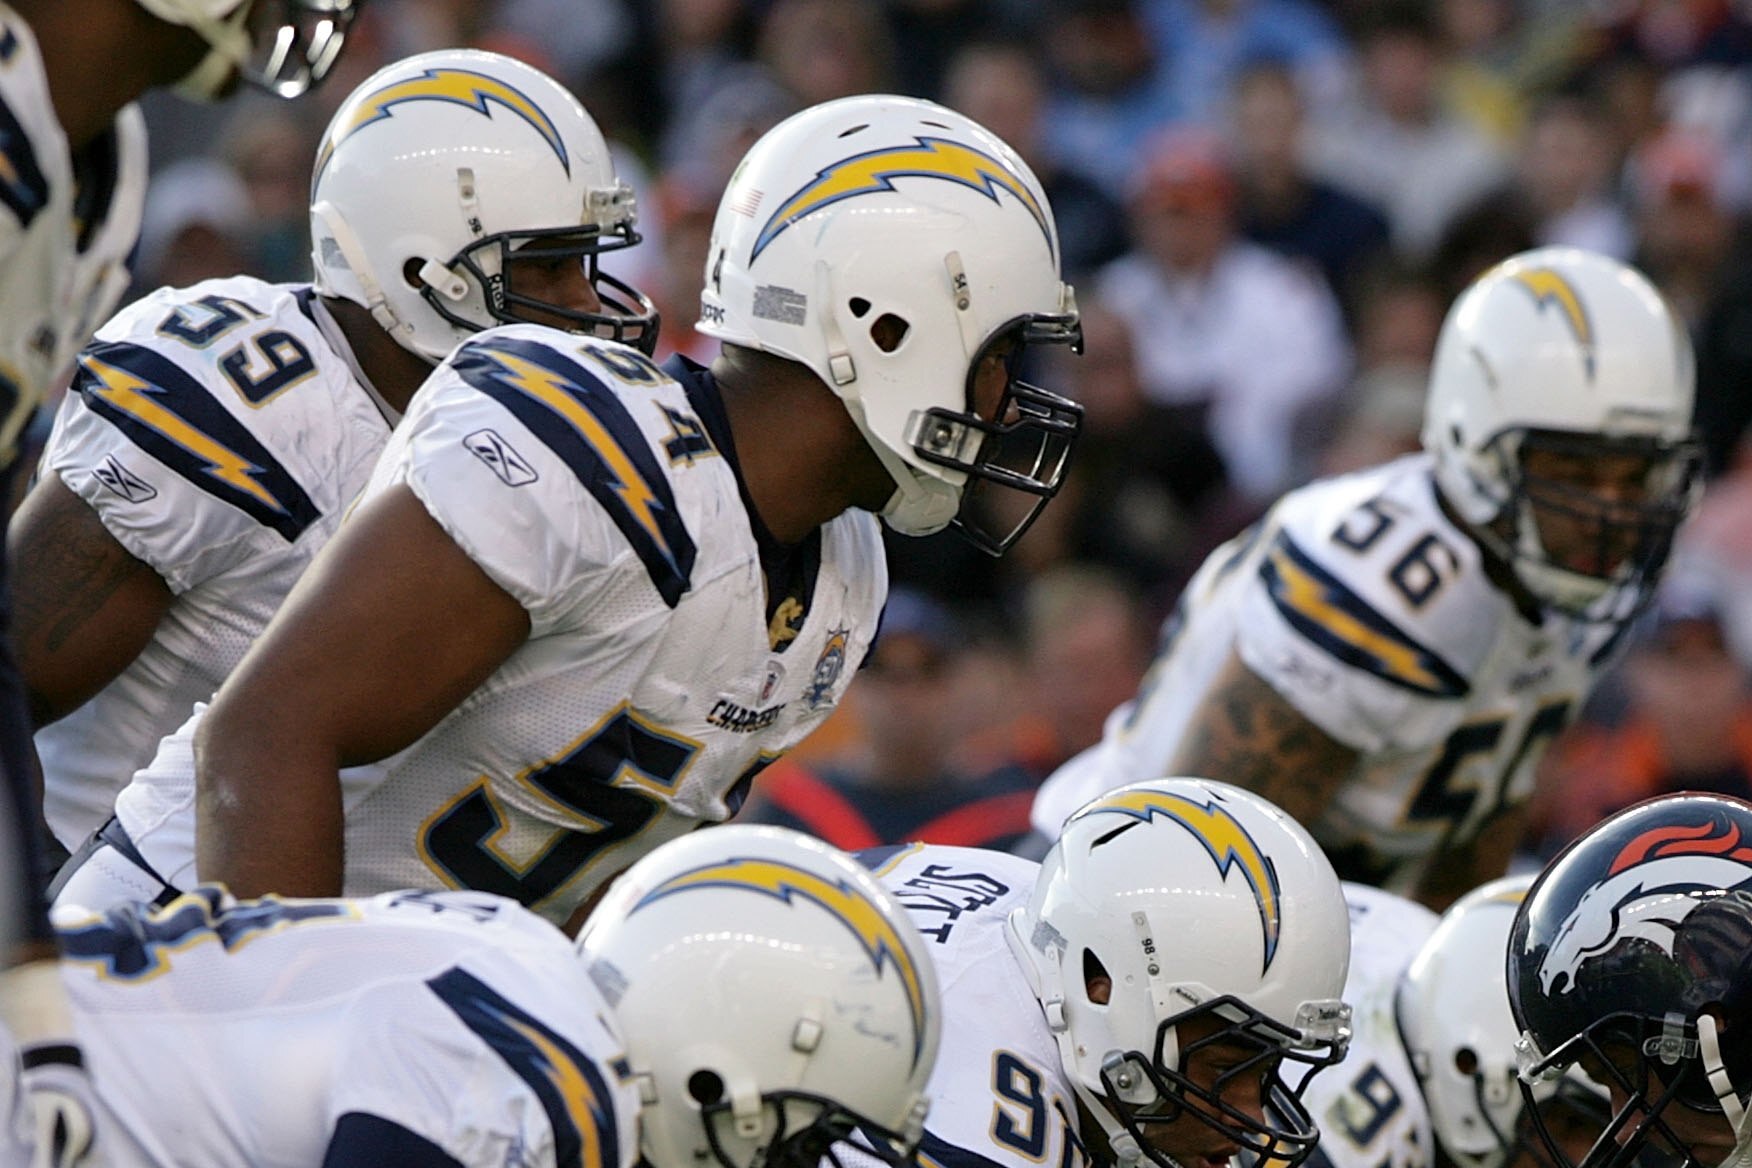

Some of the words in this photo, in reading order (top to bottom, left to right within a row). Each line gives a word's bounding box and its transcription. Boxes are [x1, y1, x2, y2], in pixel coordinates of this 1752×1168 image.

[155, 294, 320, 410] 59
[576, 344, 722, 469] 54
[1328, 495, 1464, 615] 56
[1141, 938, 1156, 955] 98
